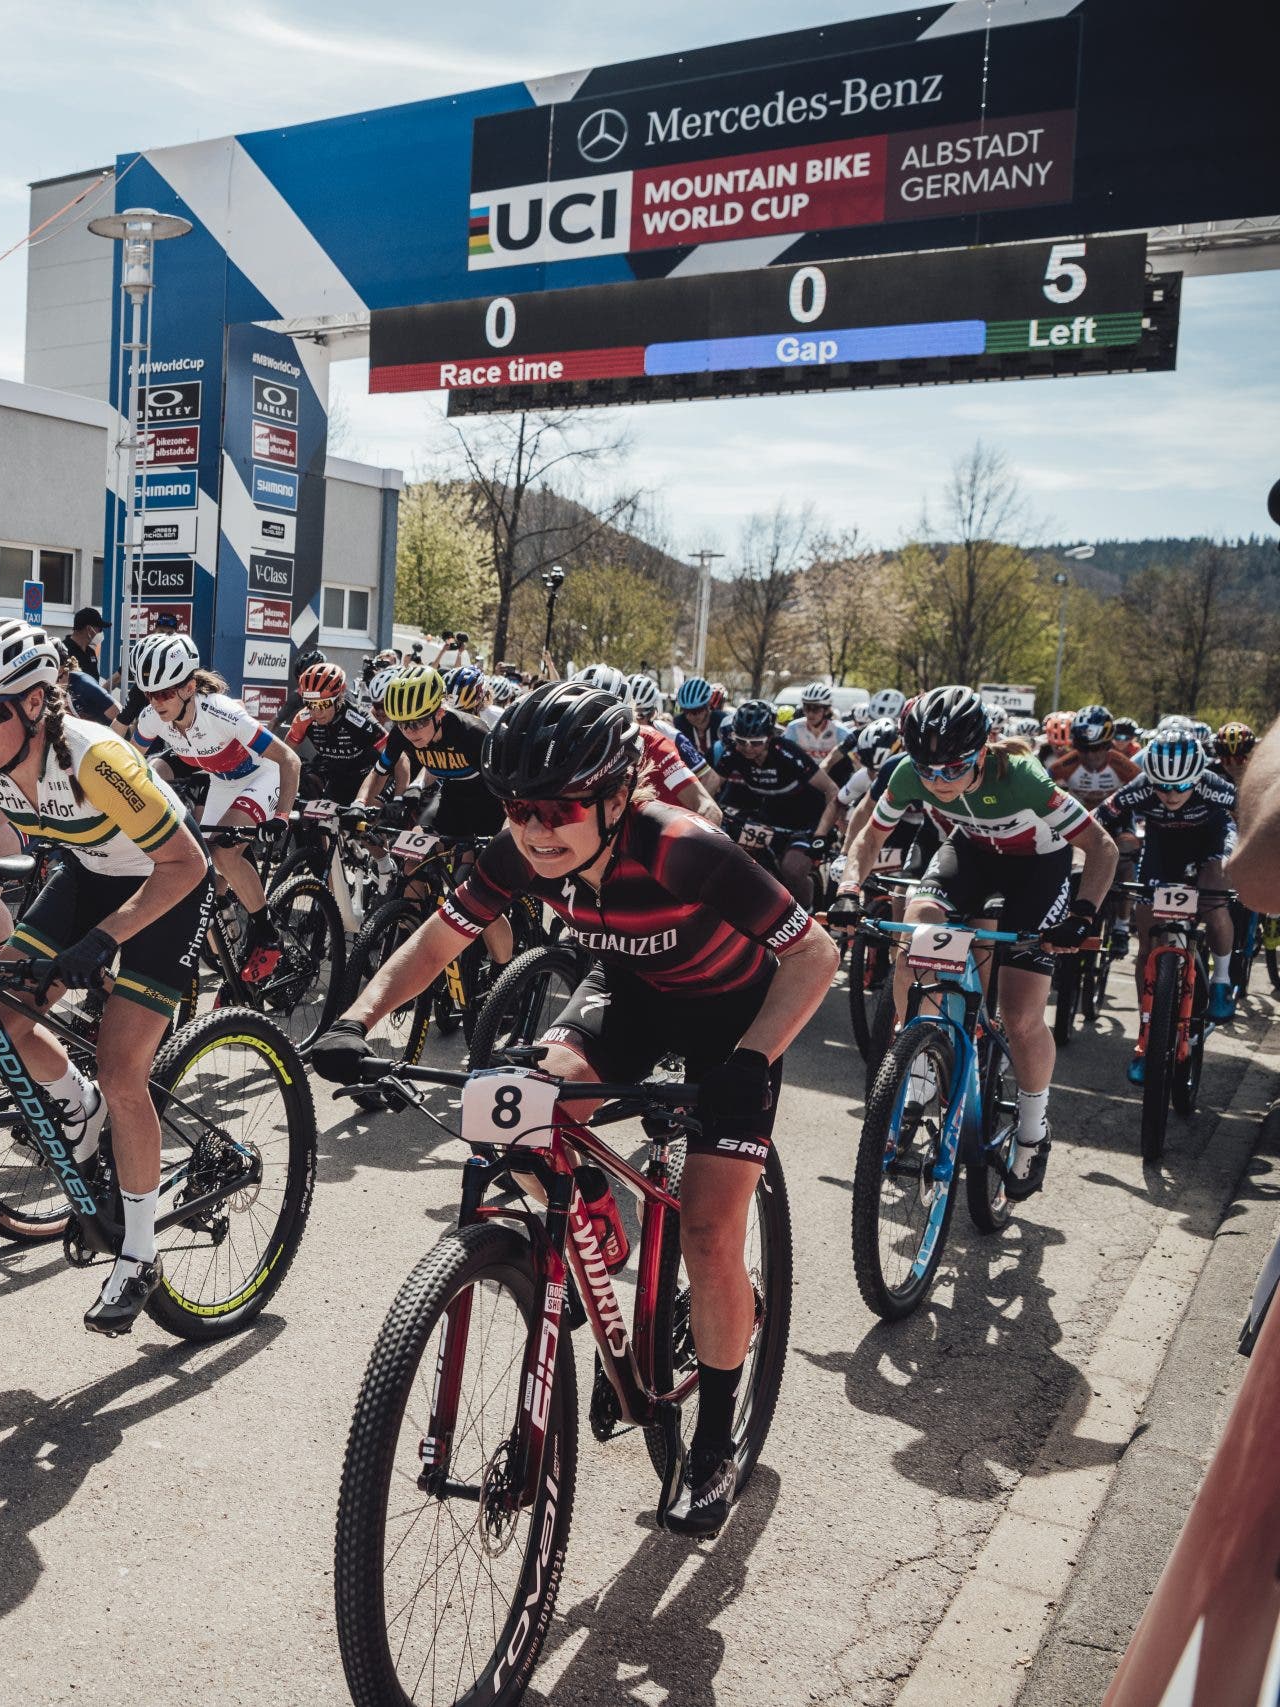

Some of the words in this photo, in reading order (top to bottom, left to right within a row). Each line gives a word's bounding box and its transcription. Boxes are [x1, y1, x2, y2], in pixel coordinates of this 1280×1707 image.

[644, 71, 944, 147] Mercedes-Benz
[900, 128, 1046, 172] ALBSTADT
[642, 159, 798, 205] MOUNTAIN
[804, 152, 871, 187] BIKE
[900, 159, 1054, 203] GERMANY
[493, 188, 619, 252] UCI
[641, 202, 746, 236] WORLD
[749, 192, 810, 223] CUP
[1042, 243, 1088, 306] 5
[788, 266, 827, 324] 0
[484, 297, 517, 350] 0
[1028, 315, 1097, 348] Left
[775, 336, 839, 366] Gap
[252, 352, 301, 379] #MBWorldCup
[440, 362, 502, 388] Race
[508, 358, 564, 384] time
[136, 406, 193, 419] OAKLEY
[256, 401, 294, 419] OAKLEY
[155, 437, 190, 447] bikezone-
[155, 446, 195, 457] albstadt.de
[134, 484, 191, 498] SHIMANO
[256, 479, 294, 498] SHIMANO
[134, 569, 184, 588] V-Class
[255, 563, 288, 585] V-Class
[24, 612, 41, 624] TAXI
[12, 646, 39, 668] GIRO
[257, 651, 287, 669] vittoria
[96, 760, 146, 814] X-SAUCE
[1119, 785, 1155, 806] FENIX
[1194, 782, 1235, 805] Alpecin
[313, 801, 331, 811] 14
[405, 832, 429, 848] 16
[745, 828, 767, 845] 38
[877, 849, 893, 863] 17
[1038, 876, 1070, 931] TRINX
[1163, 891, 1189, 907] 19
[178, 883, 216, 968] Primaflor
[442, 898, 485, 936] RAM
[767, 902, 809, 949] ROCKSH
[932, 932, 953, 951] 9
[491, 1085, 523, 1130] 8
[716, 1137, 769, 1160] SRA
[549, 1284, 564, 1298] ROC
[537, 1549, 564, 1631] RENEGADE
[521, 1636, 540, 1673] CONTROL
